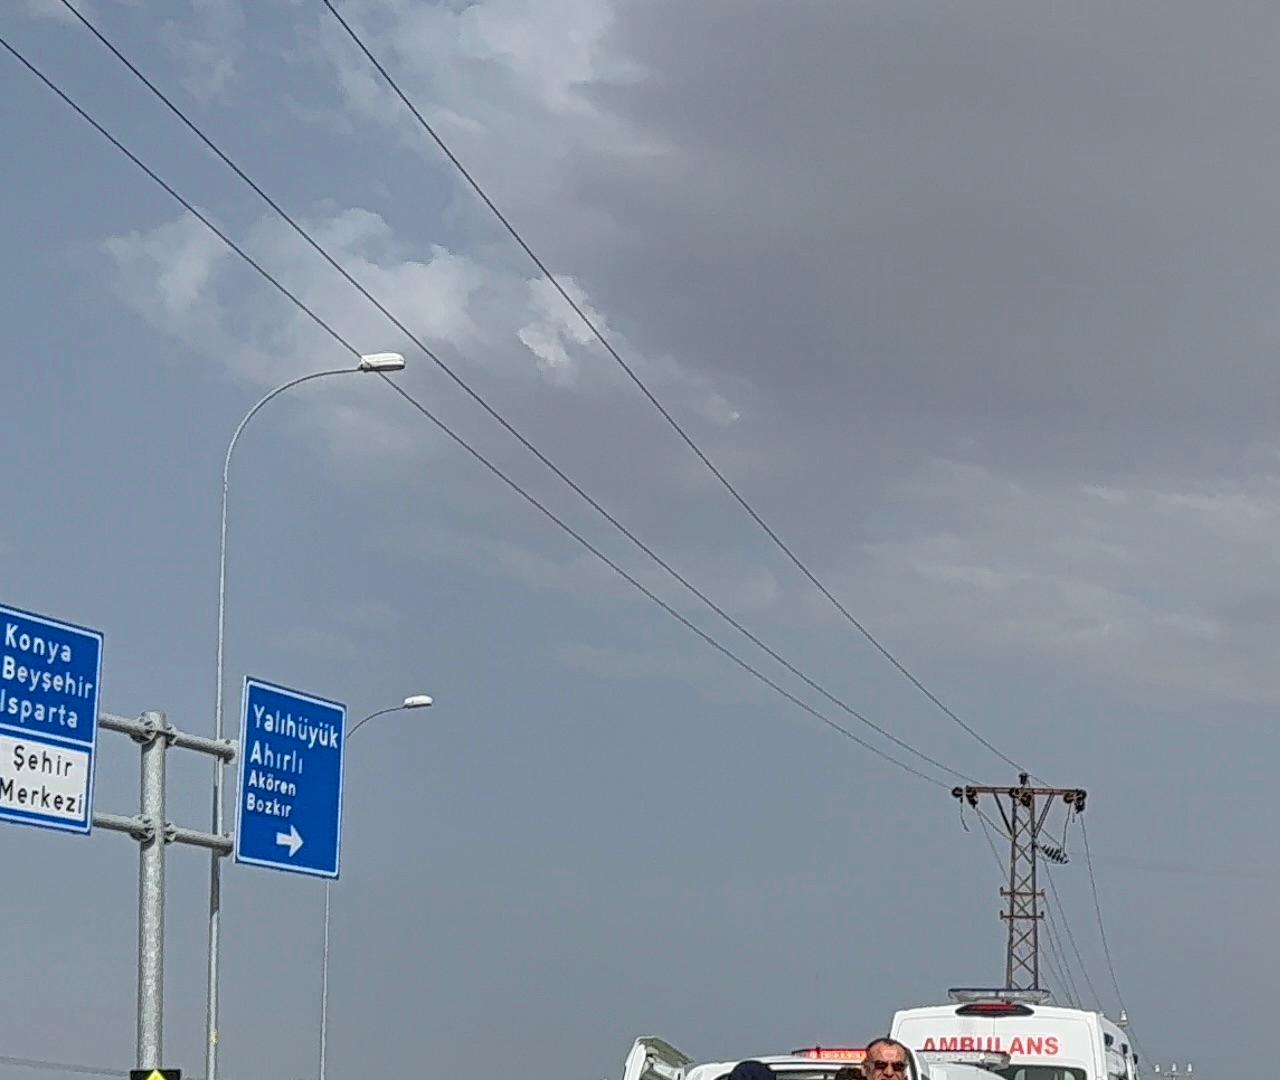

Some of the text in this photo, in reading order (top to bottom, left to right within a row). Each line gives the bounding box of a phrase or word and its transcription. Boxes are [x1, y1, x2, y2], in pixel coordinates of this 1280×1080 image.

[5, 622, 71, 665] Konya
[2, 655, 93, 699] Beyşehir
[0, 688, 78, 728] Isparta
[253, 703, 339, 749] Yalıhüyük
[13, 744, 73, 777] Şehir
[249, 740, 303, 775] Ahırlı
[0, 776, 83, 815] Merkezi
[248, 769, 296, 797] Akören
[246, 792, 292, 818] Bozkır
[922, 1036, 1059, 1056] AMBULANS
